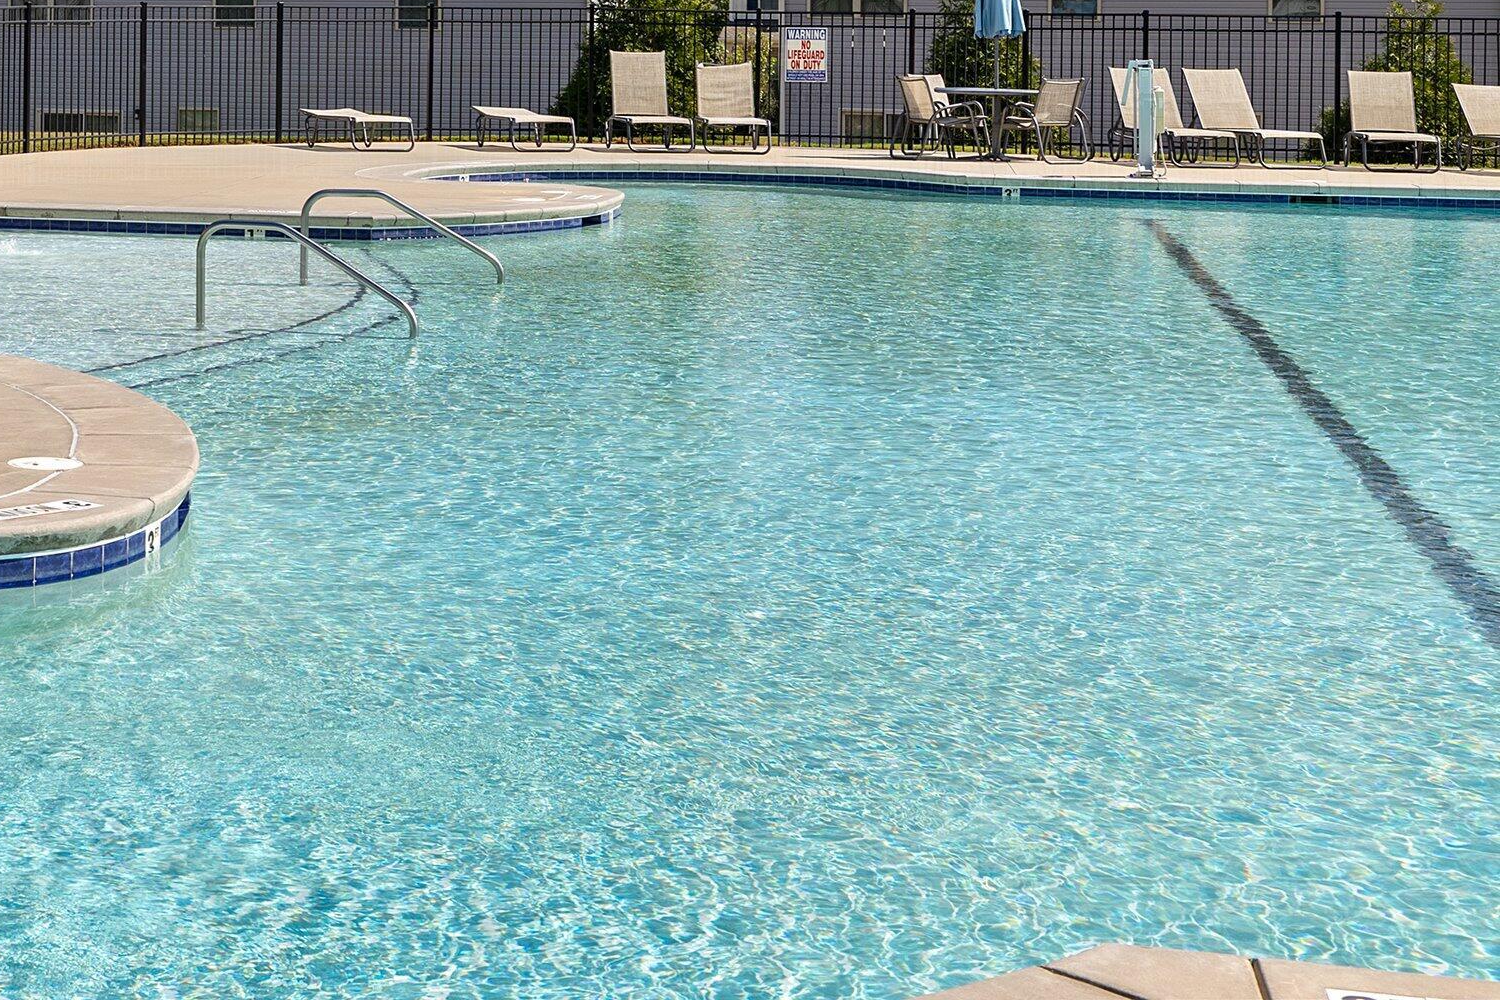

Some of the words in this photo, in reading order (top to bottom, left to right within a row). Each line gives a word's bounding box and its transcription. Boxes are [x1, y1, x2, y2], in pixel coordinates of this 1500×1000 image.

[787, 29, 826, 39] WARNING
[801, 40, 812, 50] NO
[787, 50, 826, 60] LIFEGUARD
[790, 60, 801, 69] ON
[803, 60, 822, 69] DUTY
